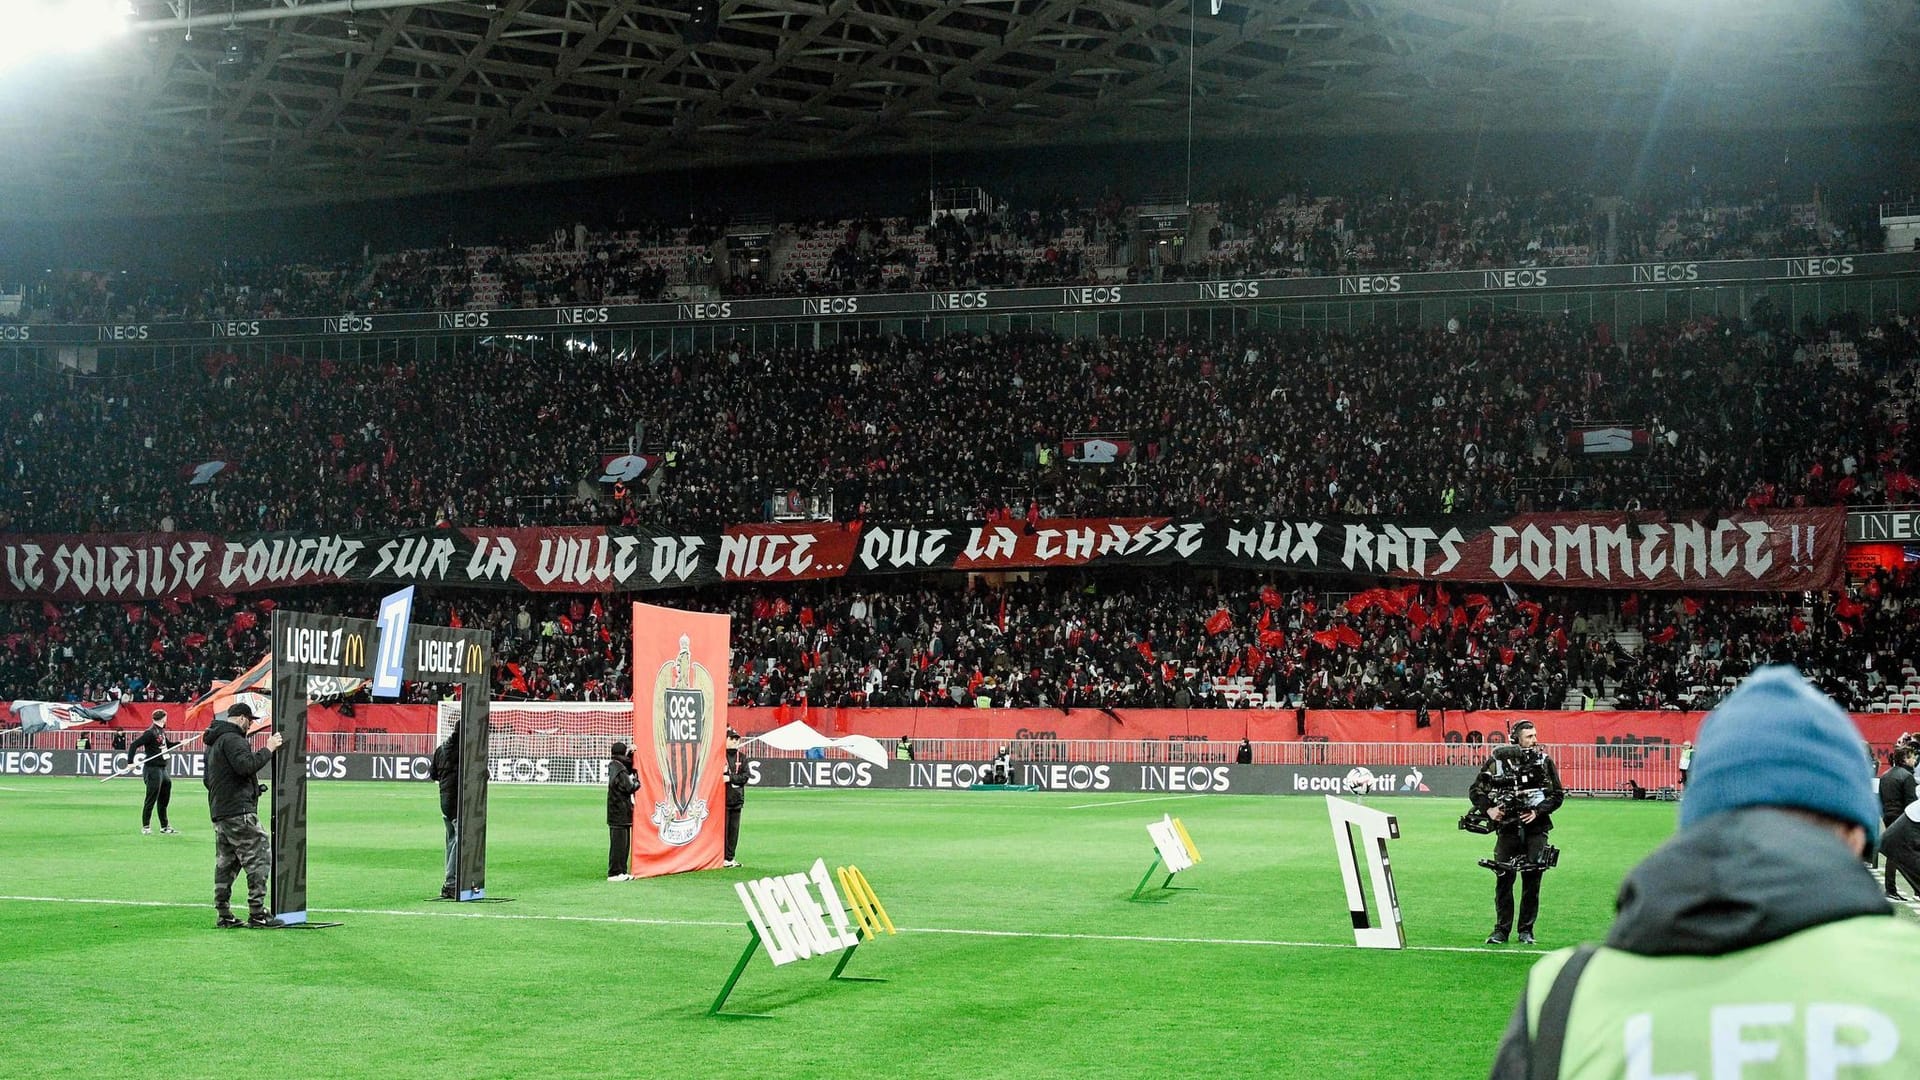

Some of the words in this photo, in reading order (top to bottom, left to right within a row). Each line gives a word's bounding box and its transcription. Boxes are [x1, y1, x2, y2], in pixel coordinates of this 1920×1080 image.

[1633, 264, 1698, 283] INEOS
[1787, 257, 1854, 277] INEOS
[1339, 276, 1401, 295] INEOS
[1484, 270, 1547, 289] INEOS
[1063, 286, 1121, 305] INEOS
[1199, 281, 1259, 300] INEOS
[802, 297, 858, 315] INEOS
[931, 291, 987, 310] INEOS
[438, 312, 489, 329] INEOS
[556, 308, 609, 324] INEOS
[677, 302, 732, 320] INEOS
[98, 325, 148, 340] INEOS
[211, 321, 260, 337] INEOS
[323, 316, 373, 333] INEOS
[1859, 513, 1920, 540] INE
[5, 543, 45, 592] LE
[368, 535, 456, 581] SUR
[466, 536, 517, 582] LA
[535, 535, 641, 585] VILLE
[650, 535, 705, 583] DE
[963, 526, 1018, 561] LA
[1341, 523, 1465, 577] RATS
[670, 695, 696, 719] OGC
[670, 718, 697, 741] NICE
[170, 754, 205, 777] INE
[372, 756, 432, 781] INEO
[575, 758, 610, 782] INE
[789, 761, 872, 786] INEOS
[1024, 764, 1110, 790] INEOS
[1141, 766, 1230, 791] INEOS
[1293, 773, 1308, 790] le
[1310, 776, 1340, 794] coq
[1624, 1001, 1901, 1080] LFP
